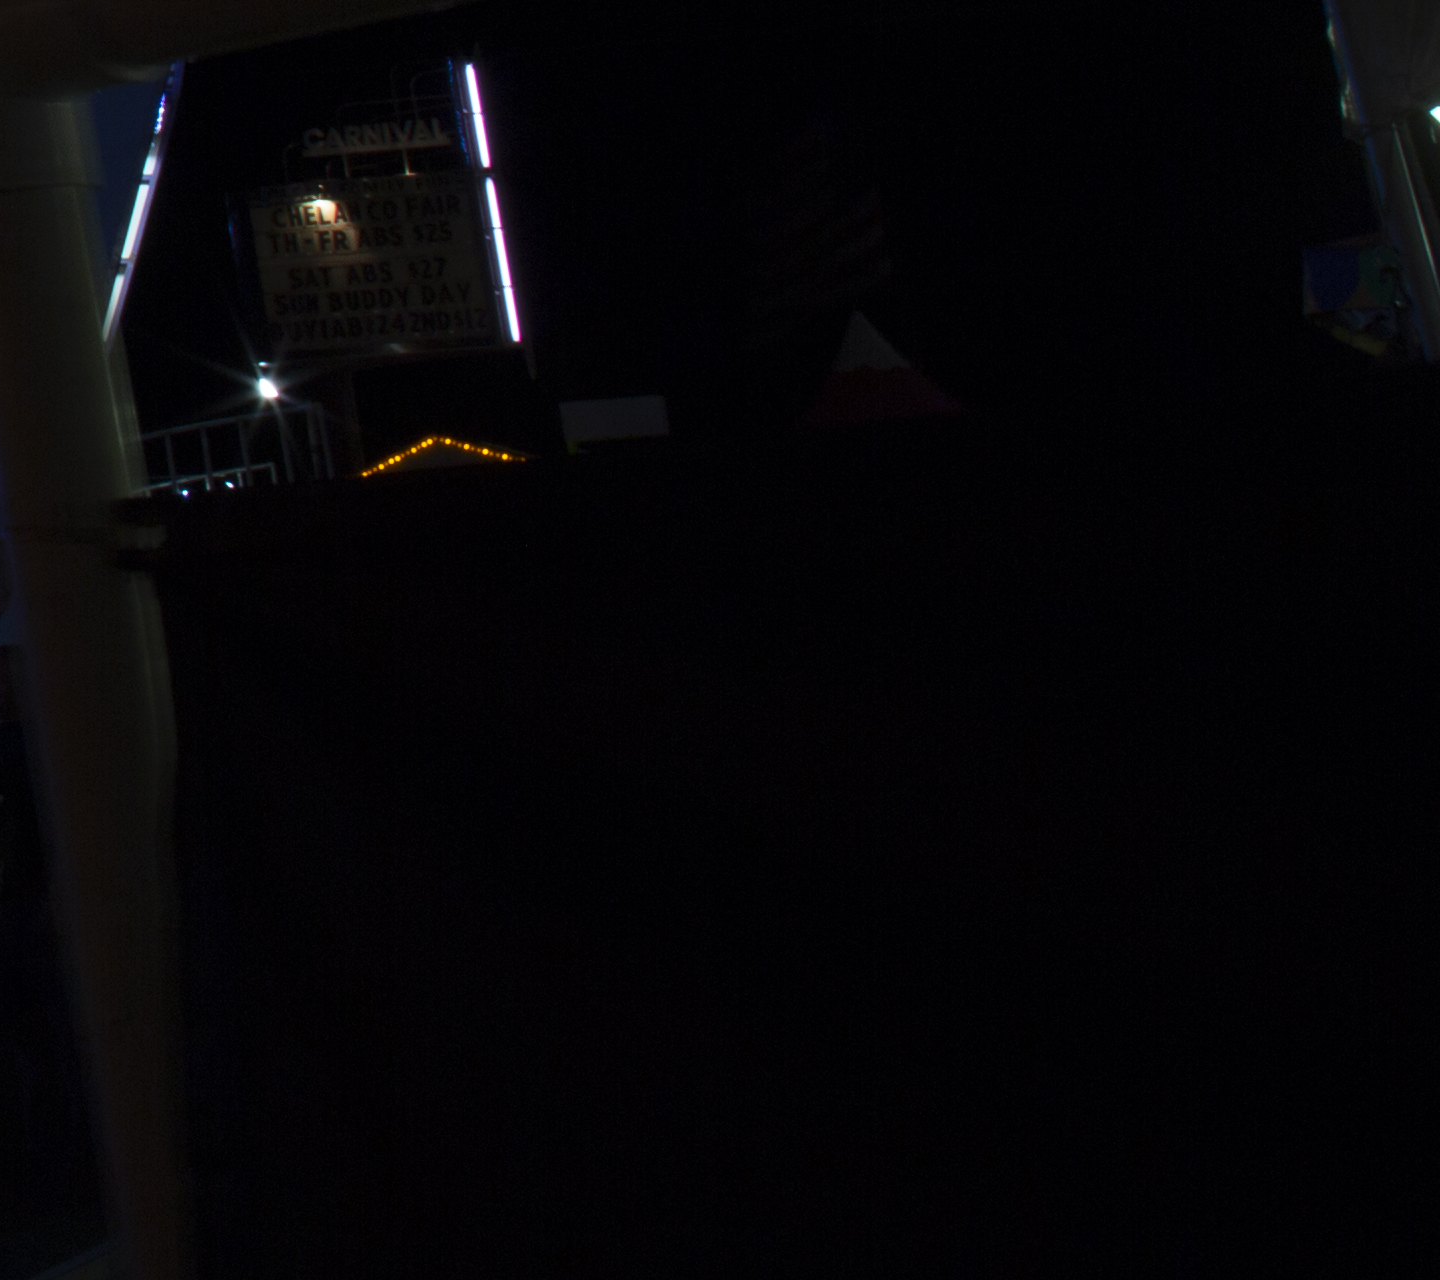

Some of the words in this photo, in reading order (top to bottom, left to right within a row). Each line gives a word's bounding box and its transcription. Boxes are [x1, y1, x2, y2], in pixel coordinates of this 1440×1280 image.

[302, 116, 449, 153] CARNIVAL
[271, 201, 362, 228] CHELAN
[368, 200, 397, 221] CO
[405, 194, 461, 217] FAIR
[359, 226, 403, 247] ABS
[413, 222, 453, 243] $25
[289, 266, 332, 290] SAT
[347, 263, 393, 286] ABS
[409, 257, 447, 279] $27
[274, 293, 319, 316] SUN
[329, 288, 409, 312] BUDDY
[421, 283, 471, 306] DAY
